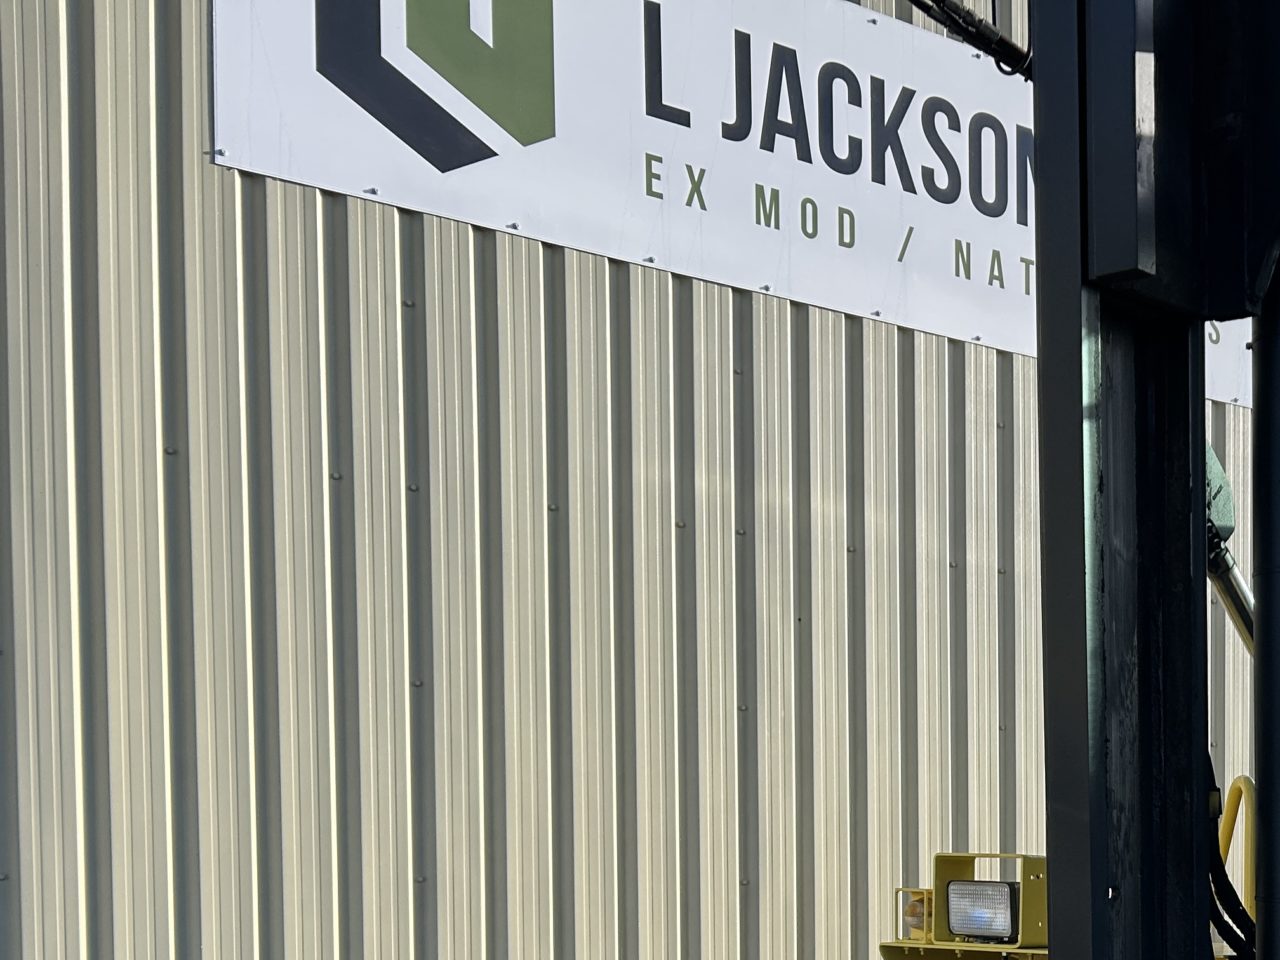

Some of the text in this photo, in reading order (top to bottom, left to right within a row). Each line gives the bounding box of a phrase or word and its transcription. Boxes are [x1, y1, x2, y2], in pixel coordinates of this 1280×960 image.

[643, 0, 691, 128] L
[645, 152, 707, 211] EX
[755, 183, 855, 249] MOD
[898, 226, 914, 262] /
